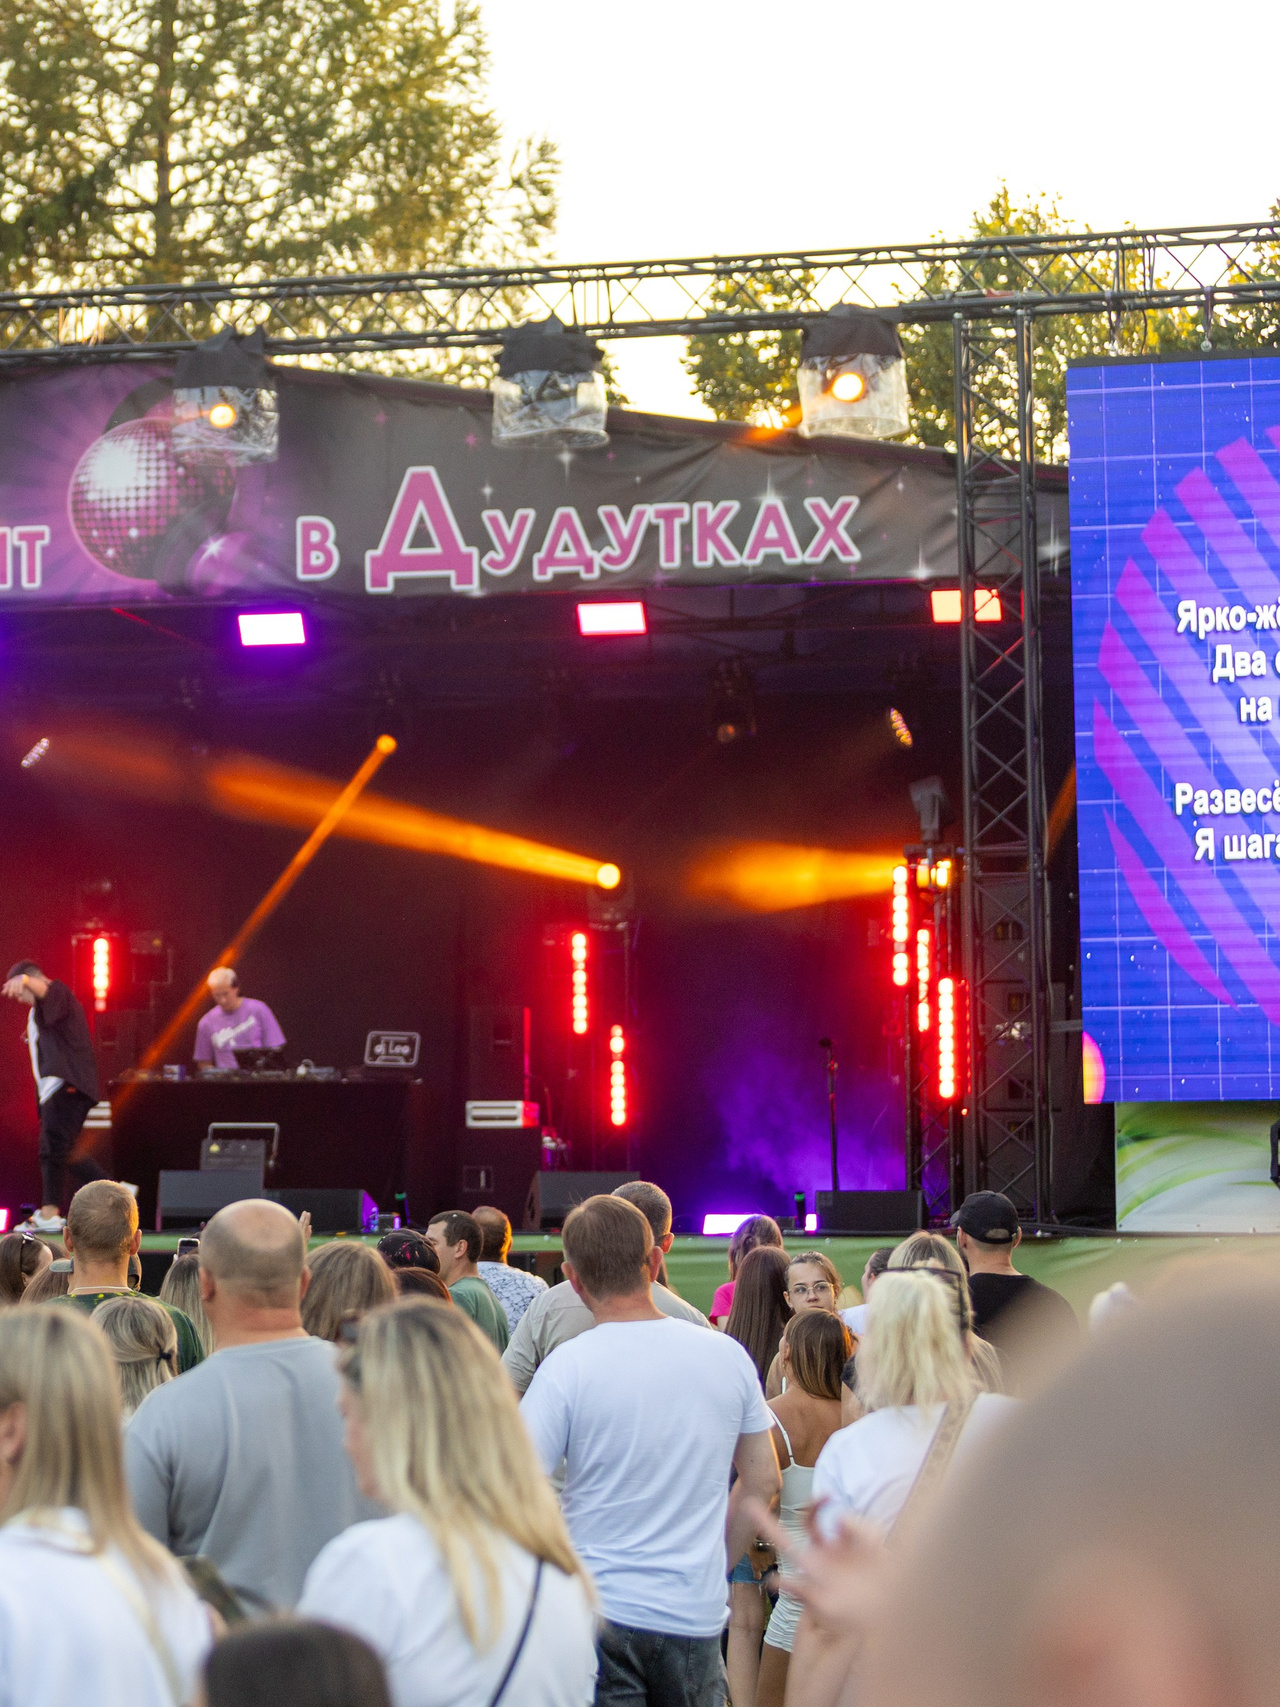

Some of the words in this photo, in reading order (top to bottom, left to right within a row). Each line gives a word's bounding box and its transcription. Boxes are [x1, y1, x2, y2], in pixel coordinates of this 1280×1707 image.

[1212, 644, 1267, 684] Два
[1240, 696, 1273, 722] на
[1194, 827, 1215, 861] Я
